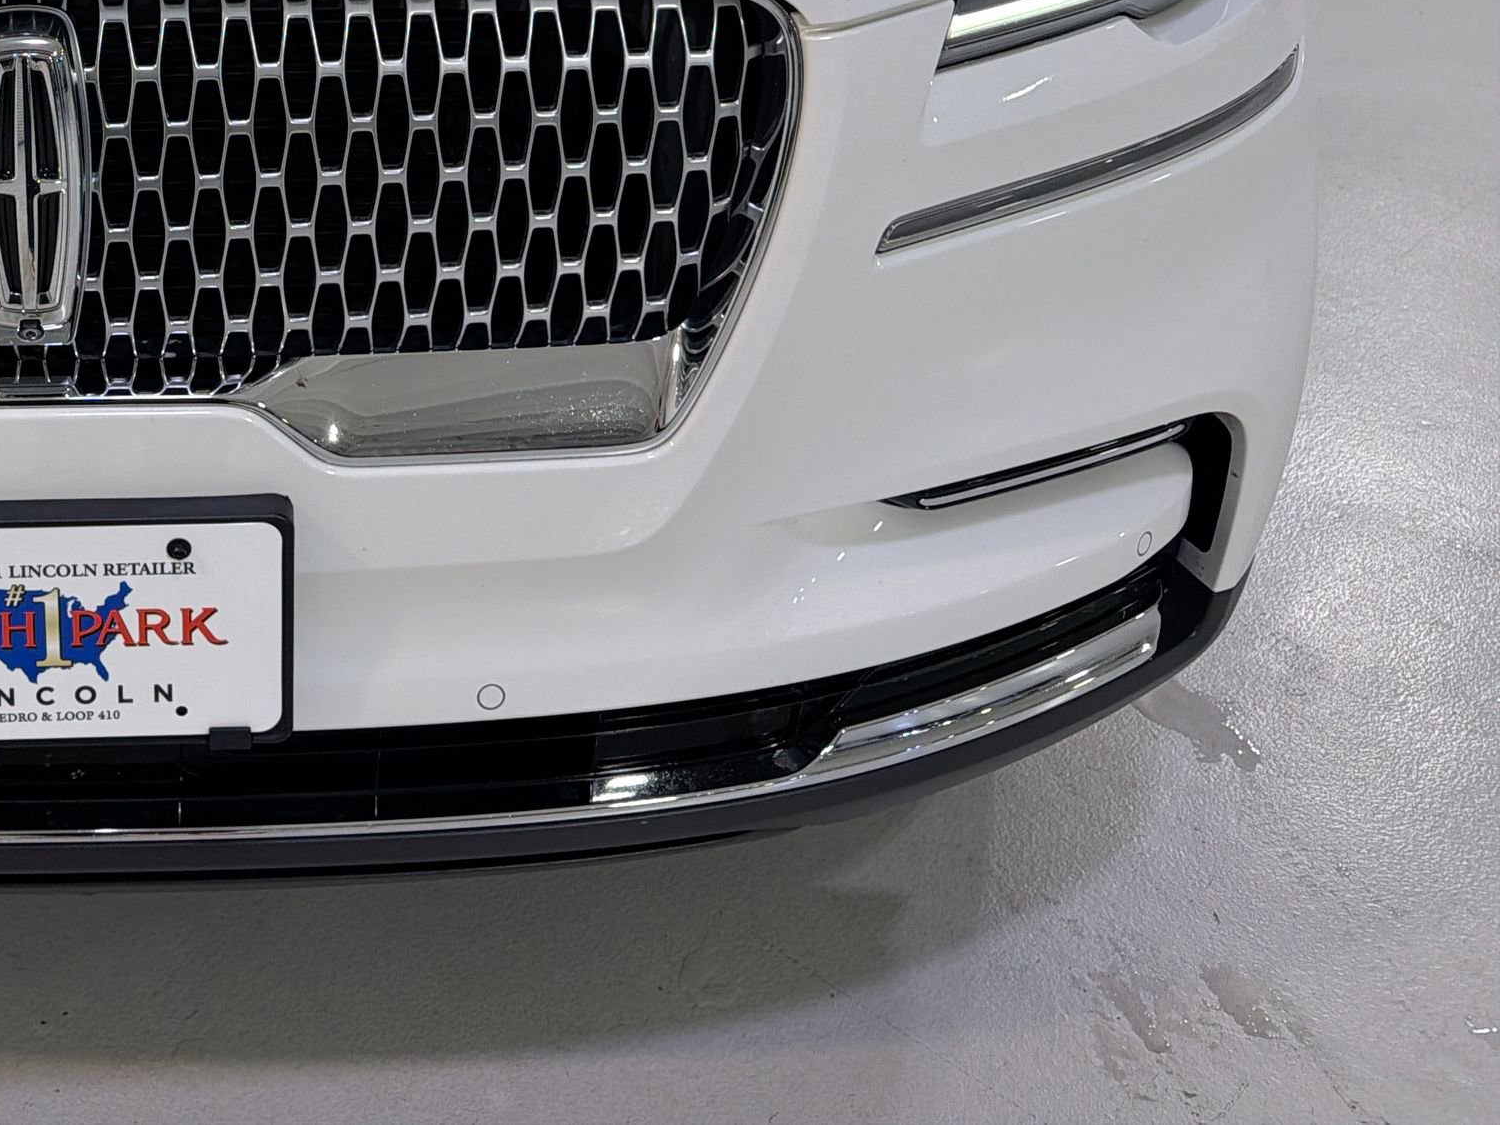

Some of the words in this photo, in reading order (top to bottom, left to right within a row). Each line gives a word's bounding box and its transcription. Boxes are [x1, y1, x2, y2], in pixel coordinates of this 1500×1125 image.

[8, 563, 98, 579] LINCOLN
[103, 561, 197, 576] RETAILER
[70, 607, 229, 648] PARK
[41, 712, 53, 722] &
[56, 710, 95, 723] LOOP
[98, 709, 121, 721] 410
